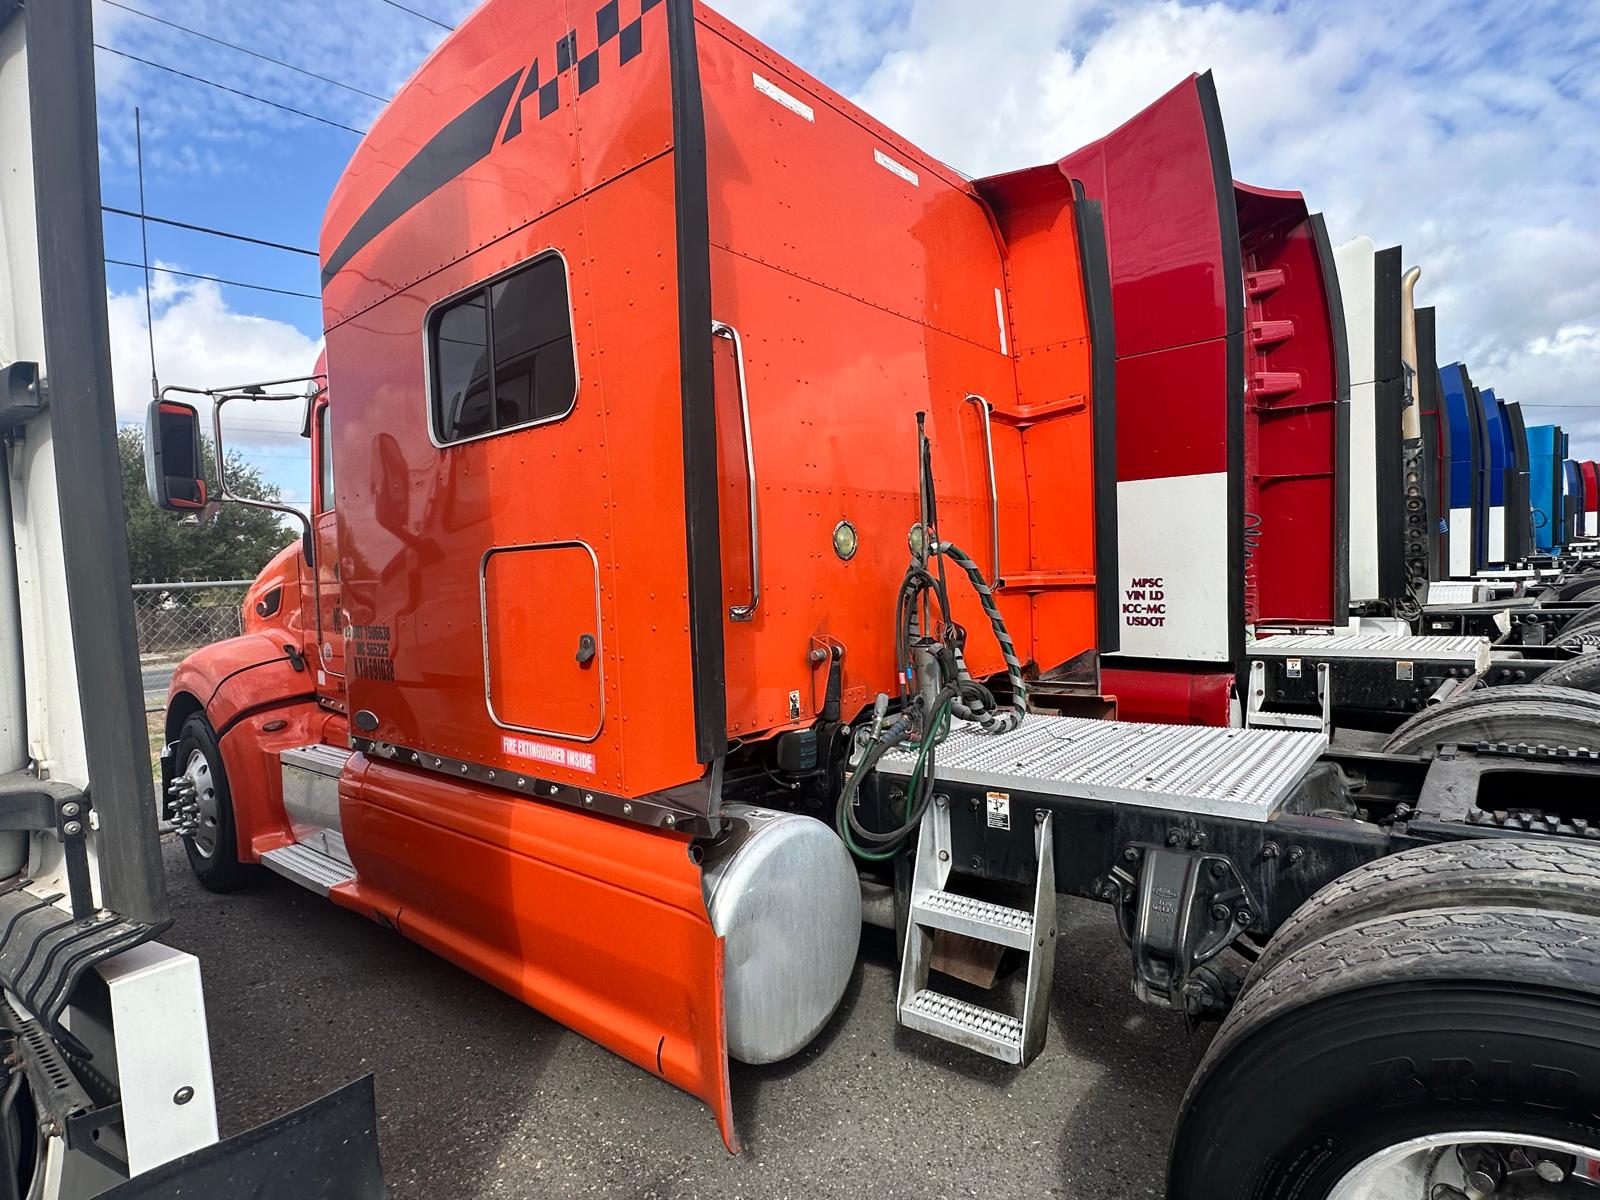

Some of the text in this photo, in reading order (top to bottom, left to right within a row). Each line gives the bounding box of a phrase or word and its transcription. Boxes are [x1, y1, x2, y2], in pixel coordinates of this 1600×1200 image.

[1131, 577, 1163, 588] MPSC
[1125, 590, 1164, 601] VIN LD
[1122, 603, 1166, 614] ICC-MC
[1126, 616, 1166, 627] USDOT
[503, 736, 593, 770] FIRE EXTINGUISHER INSIDE
